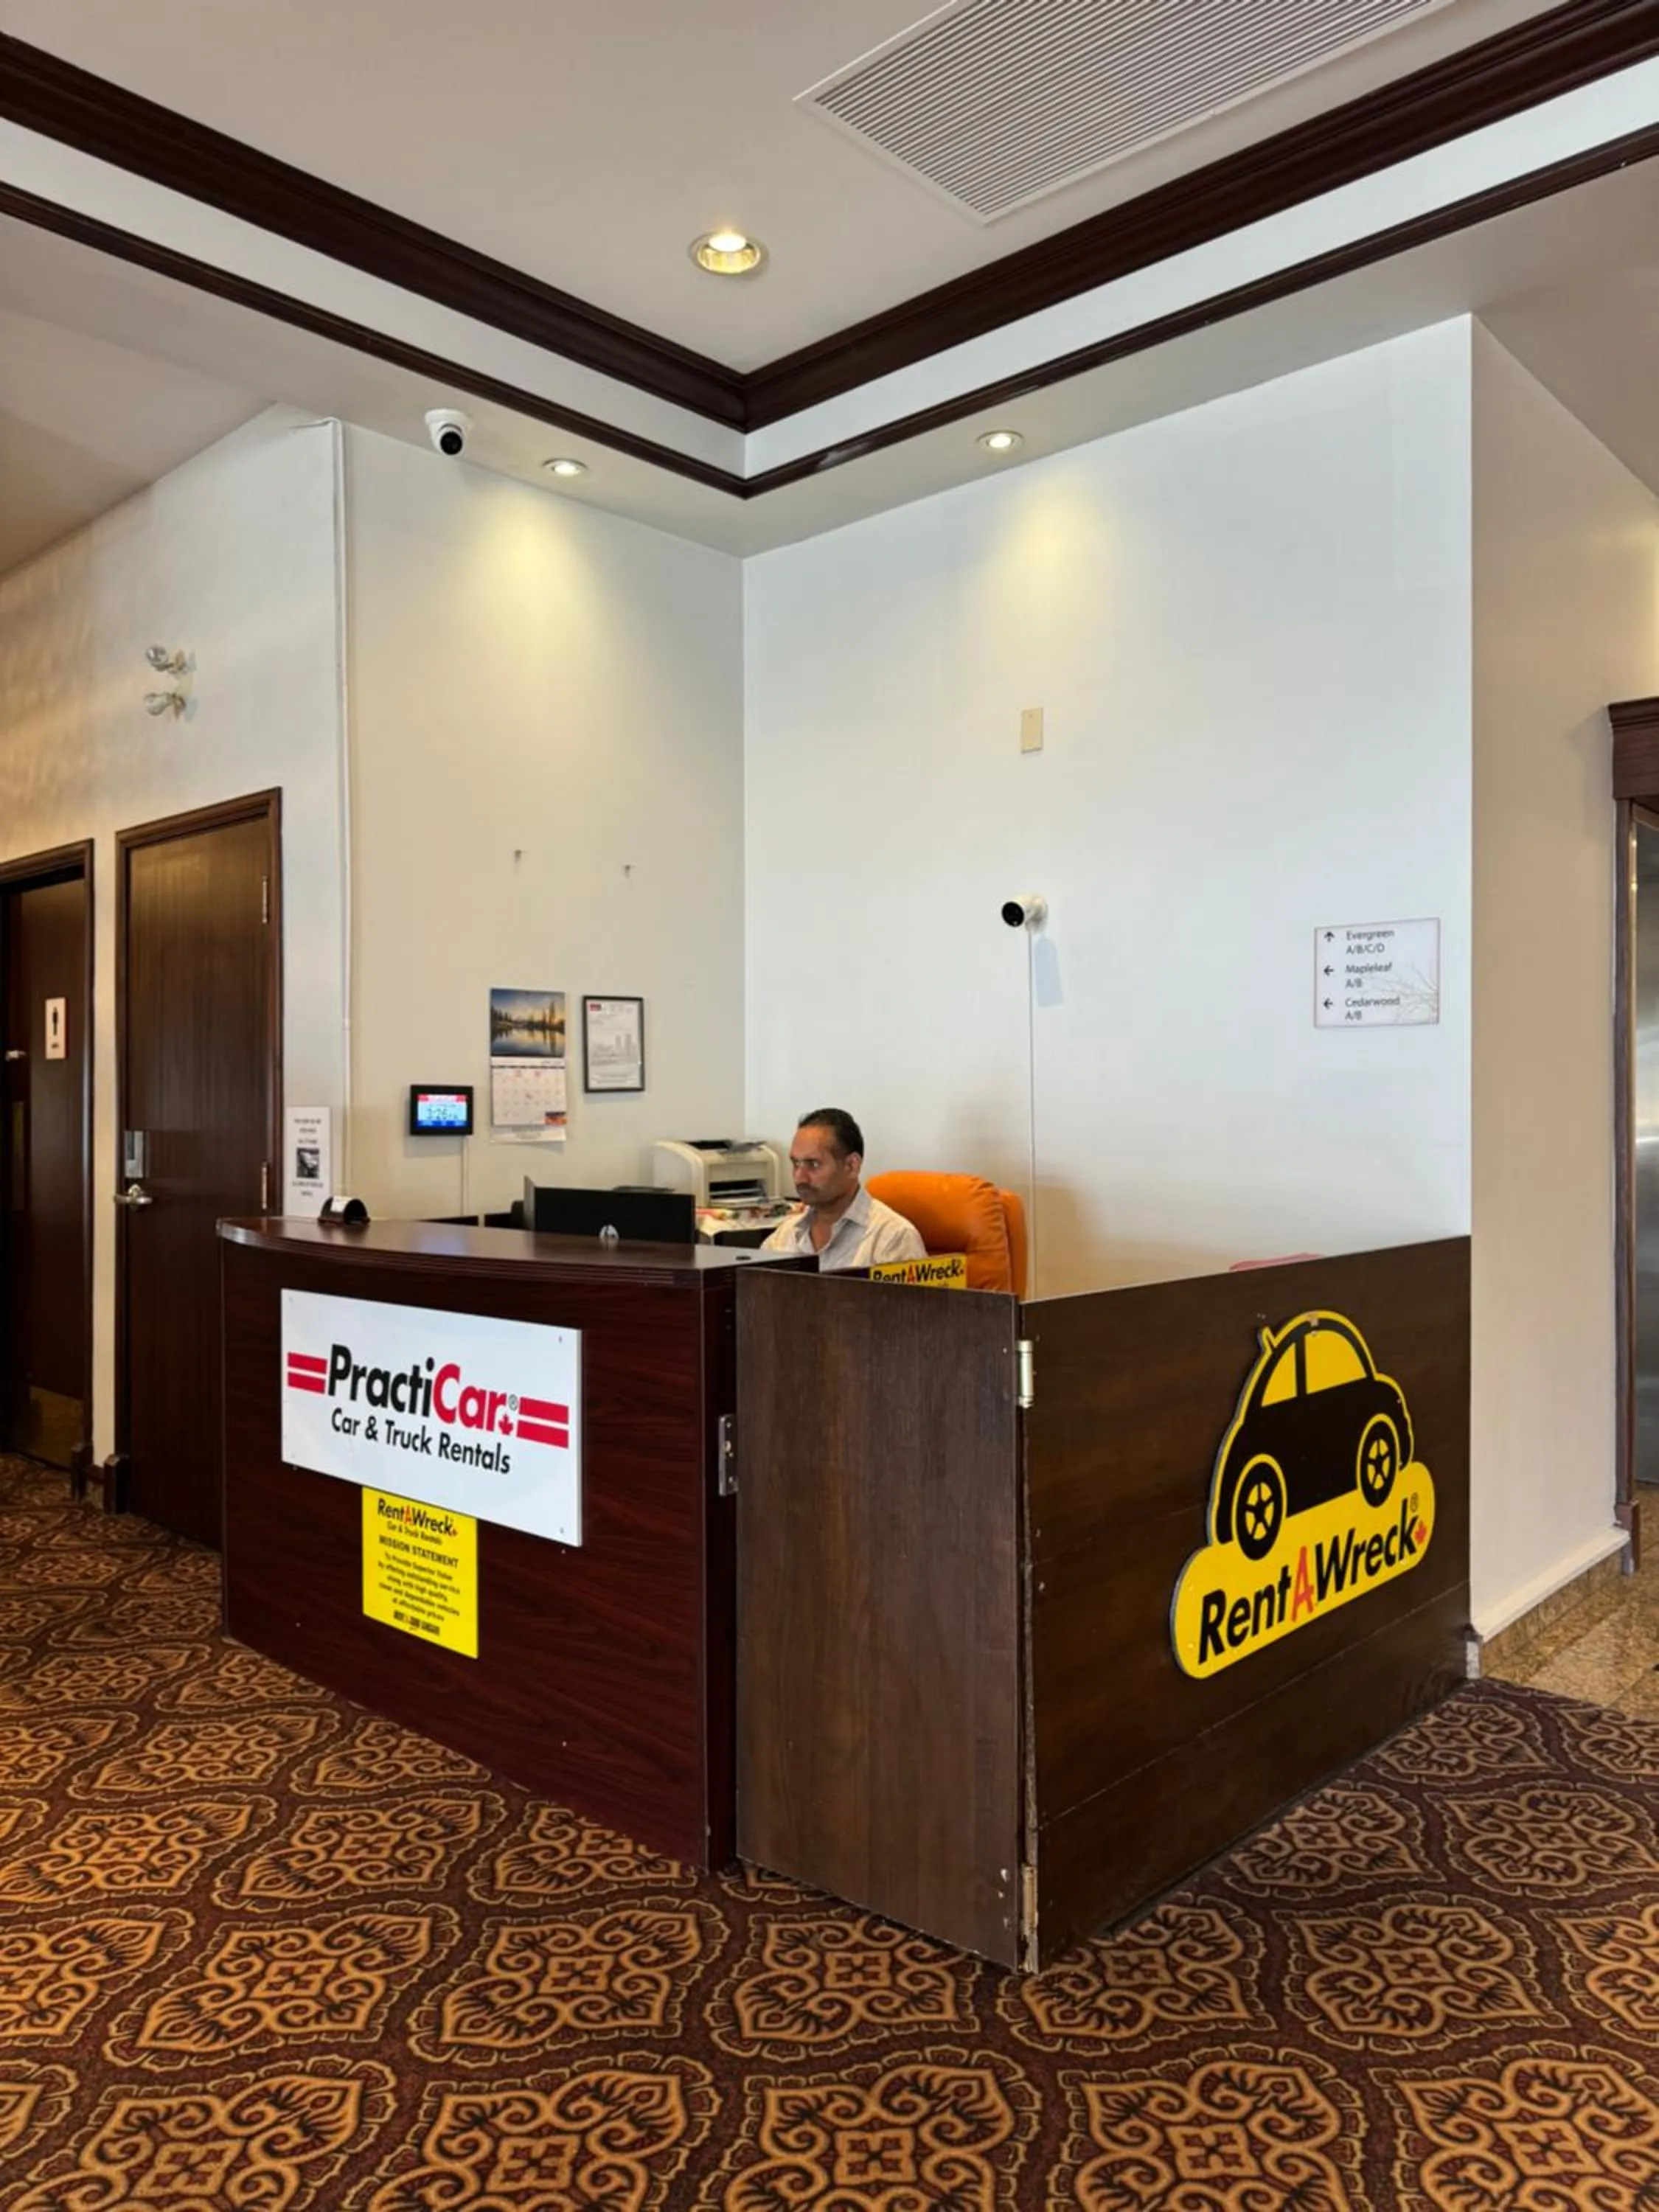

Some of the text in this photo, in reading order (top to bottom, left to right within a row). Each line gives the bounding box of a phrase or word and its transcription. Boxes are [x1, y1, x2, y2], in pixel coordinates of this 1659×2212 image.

[1346, 930, 1395, 941] Evergreen
[1346, 943, 1385, 954] A/B/C/D
[1345, 962, 1393, 974] Mapleleaf
[1345, 978, 1363, 988] A/B
[1345, 997, 1400, 1007] Cedarwood
[1345, 1011, 1363, 1020] A/B
[331, 1408, 510, 1475] Car & Truck Rentals
[379, 1534, 459, 1569] MISSION STATEMENT
